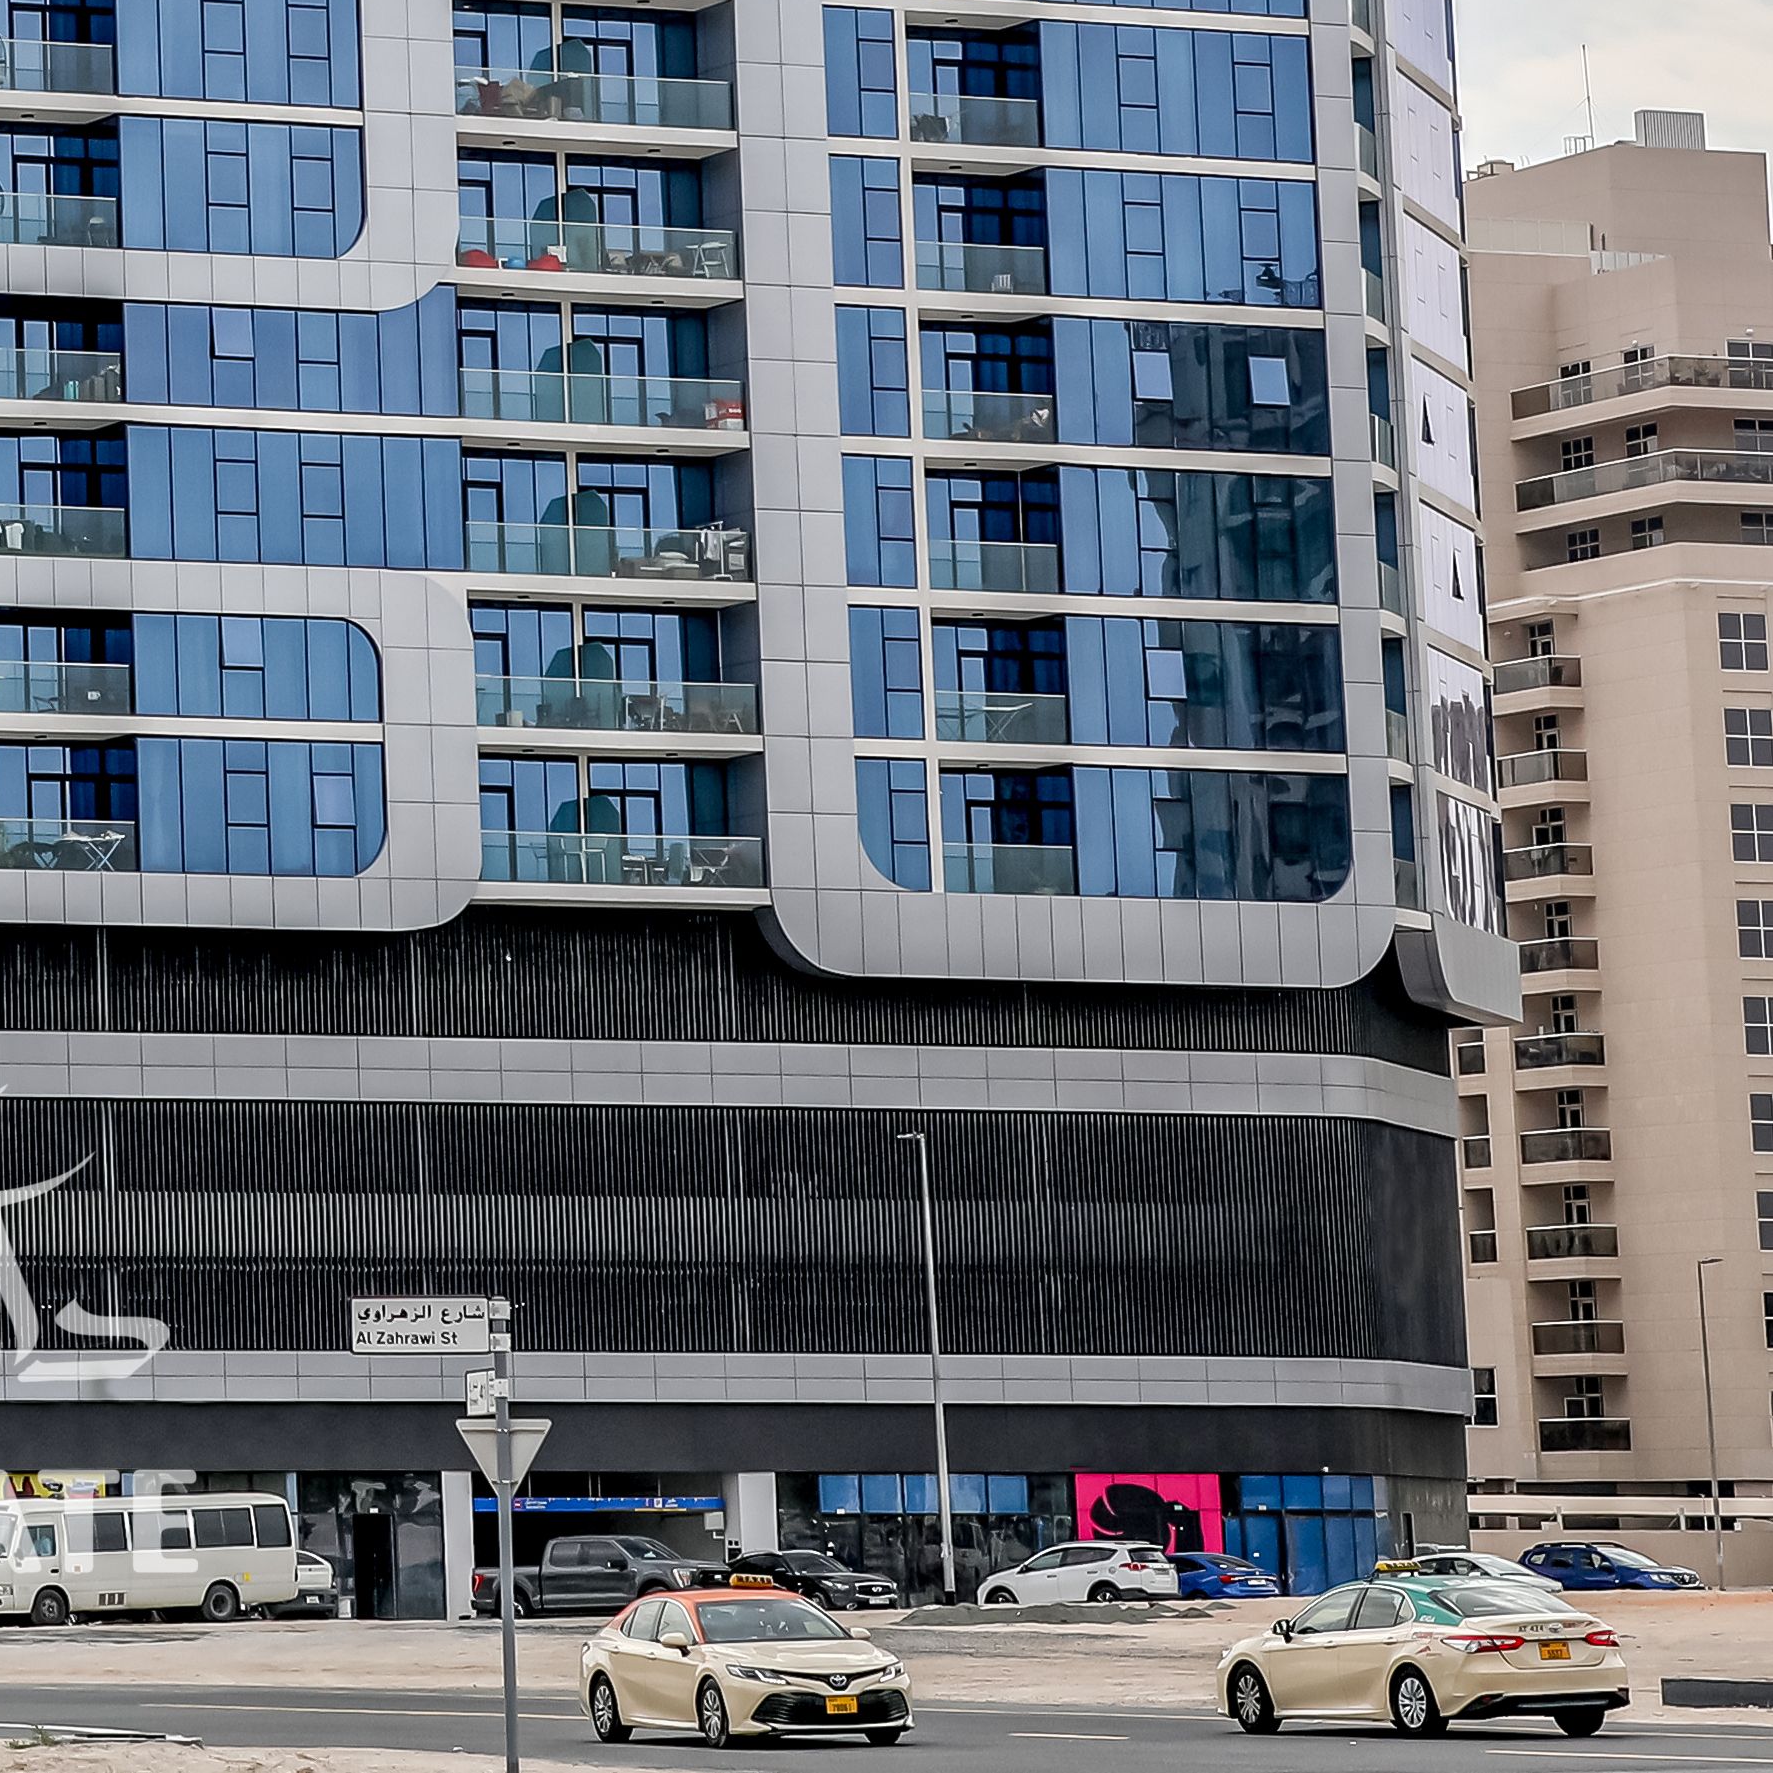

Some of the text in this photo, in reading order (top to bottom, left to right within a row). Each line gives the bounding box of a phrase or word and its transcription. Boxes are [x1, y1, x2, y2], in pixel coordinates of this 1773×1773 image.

[357, 1304, 485, 1325] شارع الزهراوي
[356, 1331, 458, 1345] Al Zahrawi St
